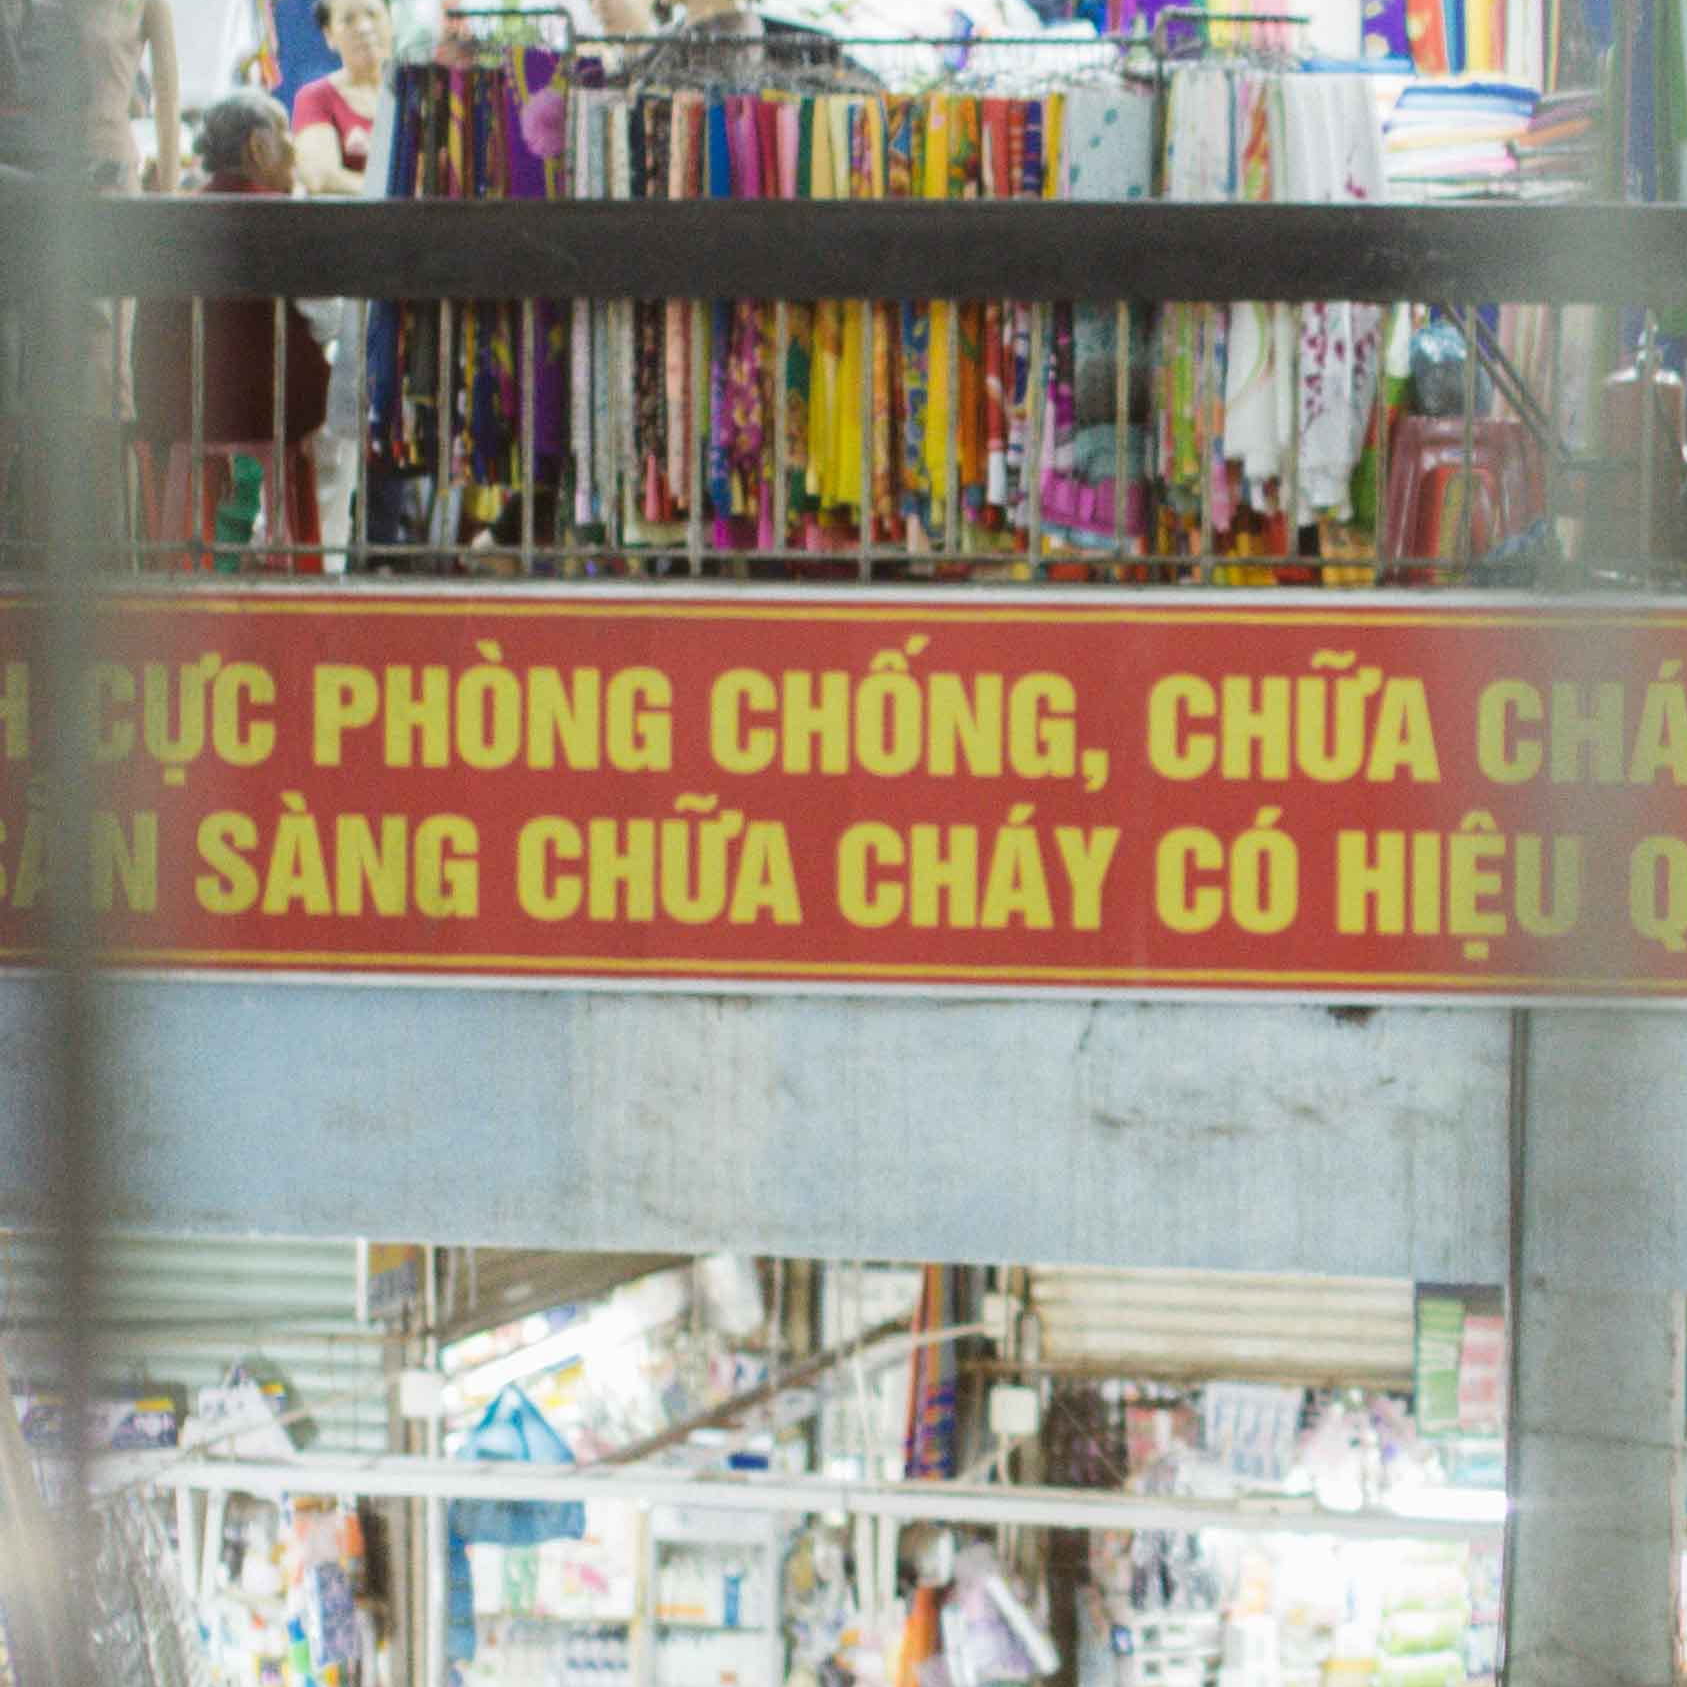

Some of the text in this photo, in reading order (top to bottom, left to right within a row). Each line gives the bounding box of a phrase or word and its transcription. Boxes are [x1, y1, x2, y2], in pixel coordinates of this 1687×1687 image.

[82, 651, 277, 786] CỰC
[313, 639, 673, 772] PHÒNG
[709, 634, 1110, 793] CHỐNG,
[1146, 649, 1441, 783] CHỮA
[194, 791, 480, 920] SÀNG
[516, 793, 803, 926] CHỮA
[836, 803, 1120, 931] CHÁY
[1155, 805, 1299, 934] CÓ
[1336, 809, 1581, 961] HIỆU
